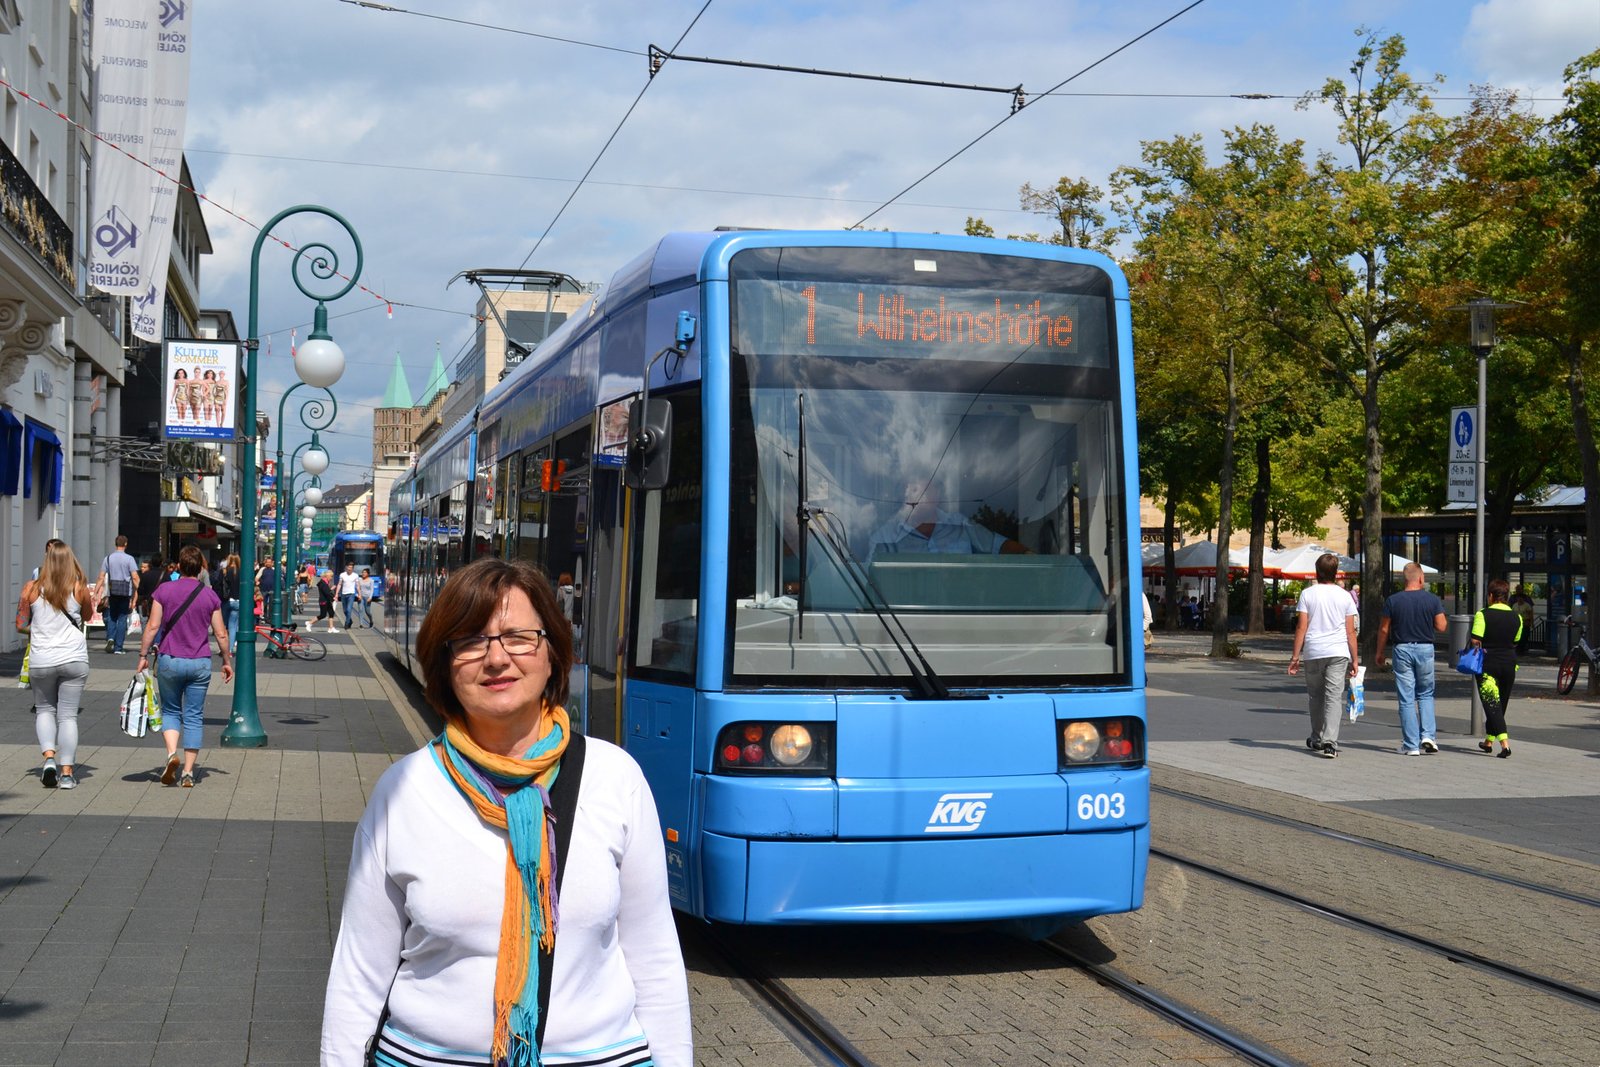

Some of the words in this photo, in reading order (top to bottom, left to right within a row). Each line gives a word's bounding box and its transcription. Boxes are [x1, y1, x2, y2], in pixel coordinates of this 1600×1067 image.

[801, 286, 816, 344] 1
[857, 292, 1073, 347] Wilhelmshöhe
[173, 355, 219, 364] SOMMER
[174, 346, 219, 357] KULTUR
[1455, 450, 1471, 459] ZONE
[929, 801, 987, 824] KVG
[1077, 792, 1126, 820] 603
